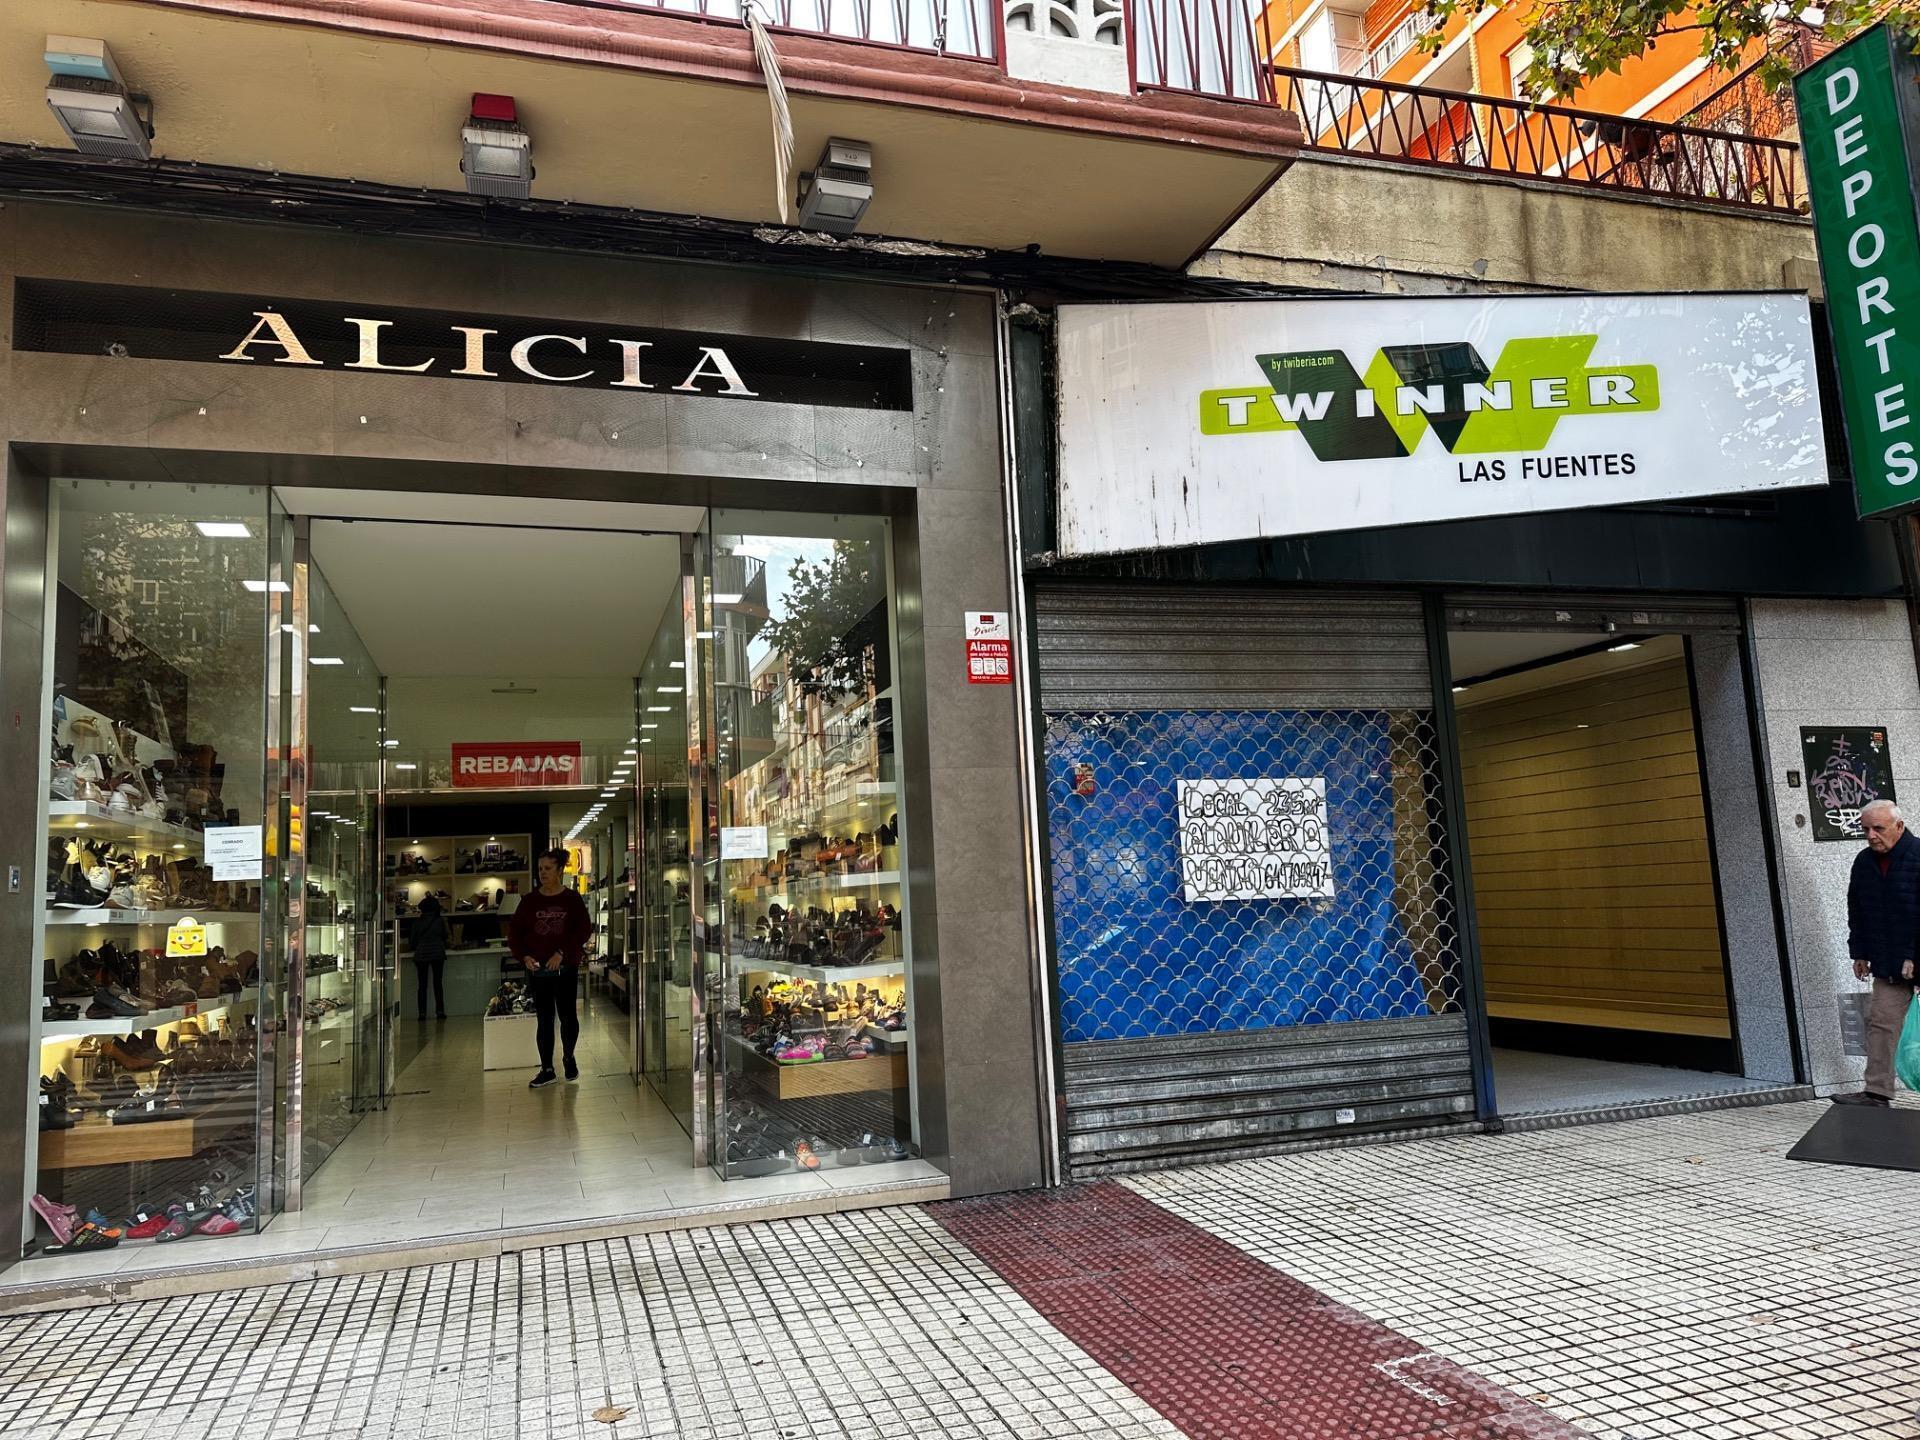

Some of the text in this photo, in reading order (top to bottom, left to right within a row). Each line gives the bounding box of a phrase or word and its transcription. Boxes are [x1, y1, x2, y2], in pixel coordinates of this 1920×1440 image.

[1825, 66, 1919, 486] DEPORTES
[218, 311, 760, 396] ALICIA
[1271, 355, 1335, 373] by twiberia.com
[1217, 374, 1640, 427] TWINNER
[1458, 453, 1637, 483] LAS FUENTES
[970, 641, 1008, 651] Alarma
[459, 754, 575, 774] REBAJAS
